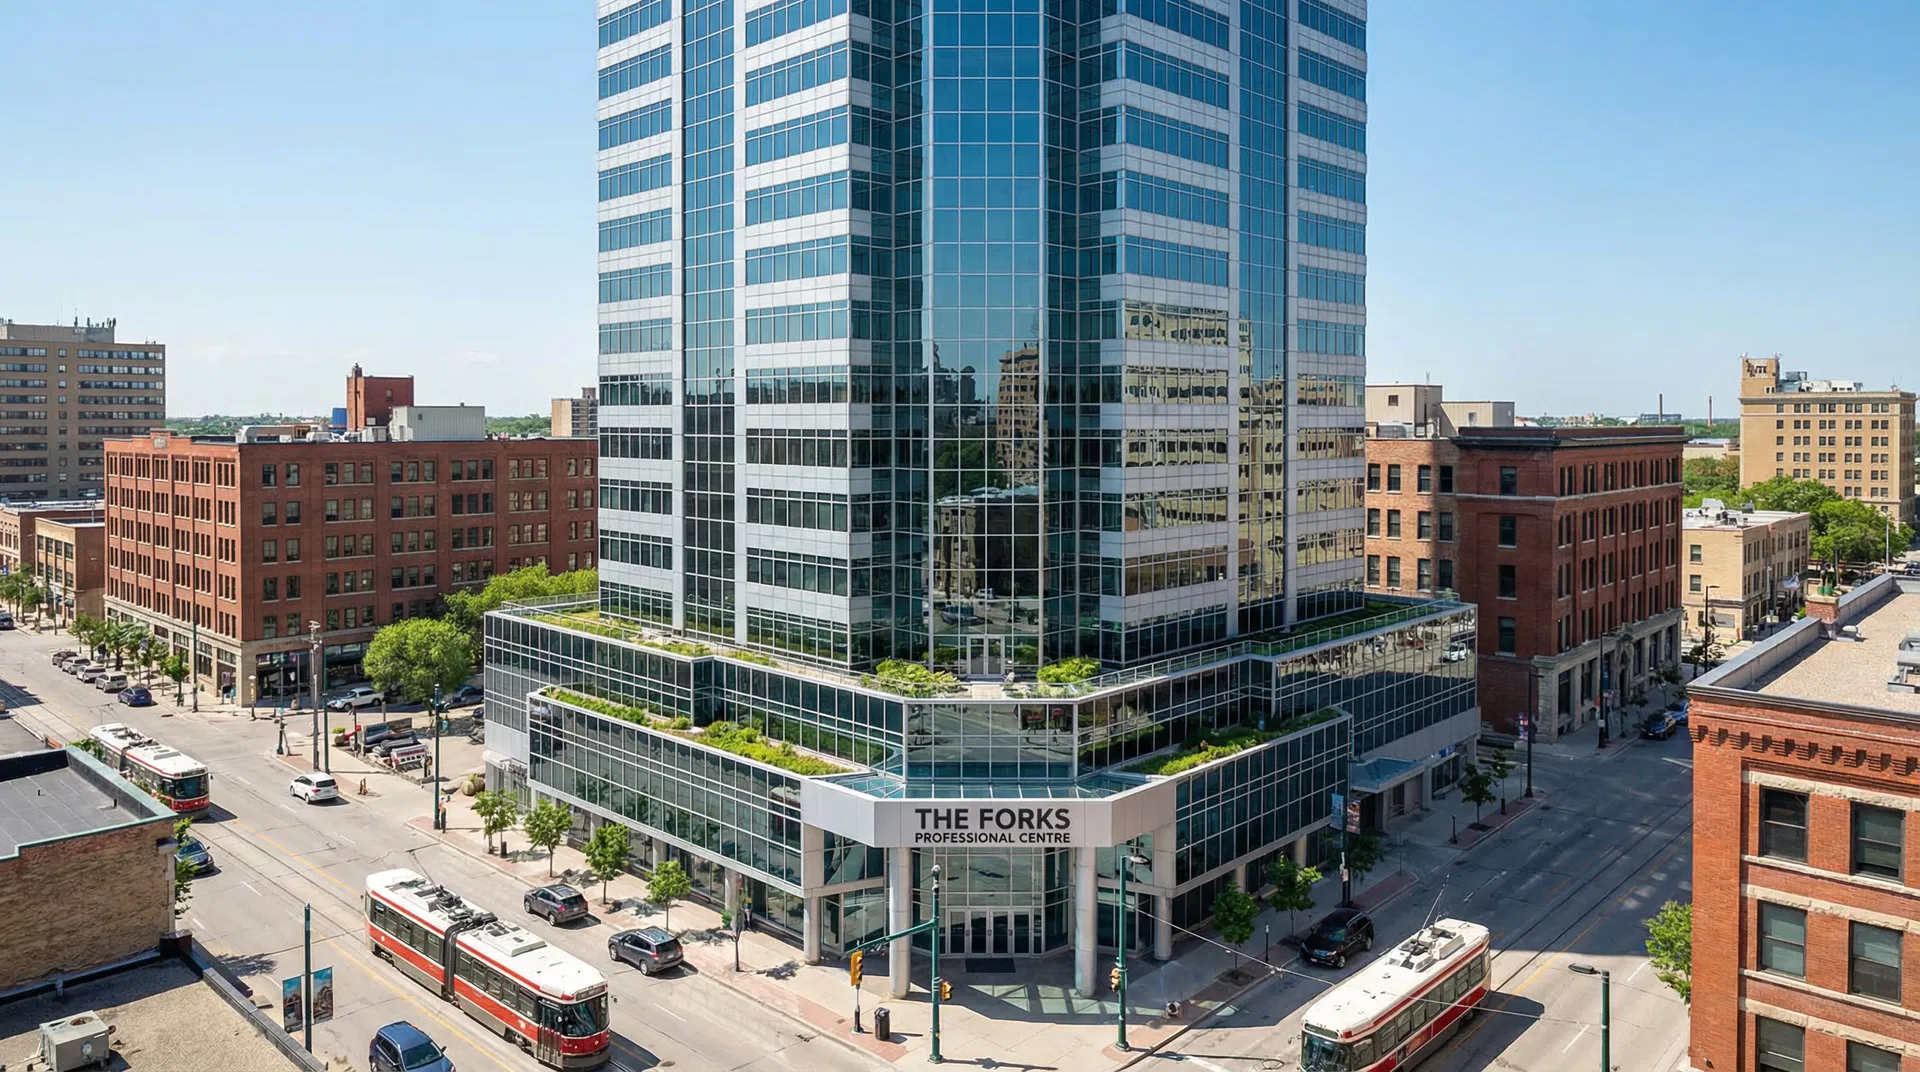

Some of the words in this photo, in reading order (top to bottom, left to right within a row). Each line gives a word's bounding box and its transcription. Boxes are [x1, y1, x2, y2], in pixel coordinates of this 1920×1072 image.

[915, 808, 969, 830] THE
[979, 808, 1071, 830] FORKS
[915, 832, 1015, 844] PROFESSIONAL
[1019, 832, 1071, 844] CENTRE
